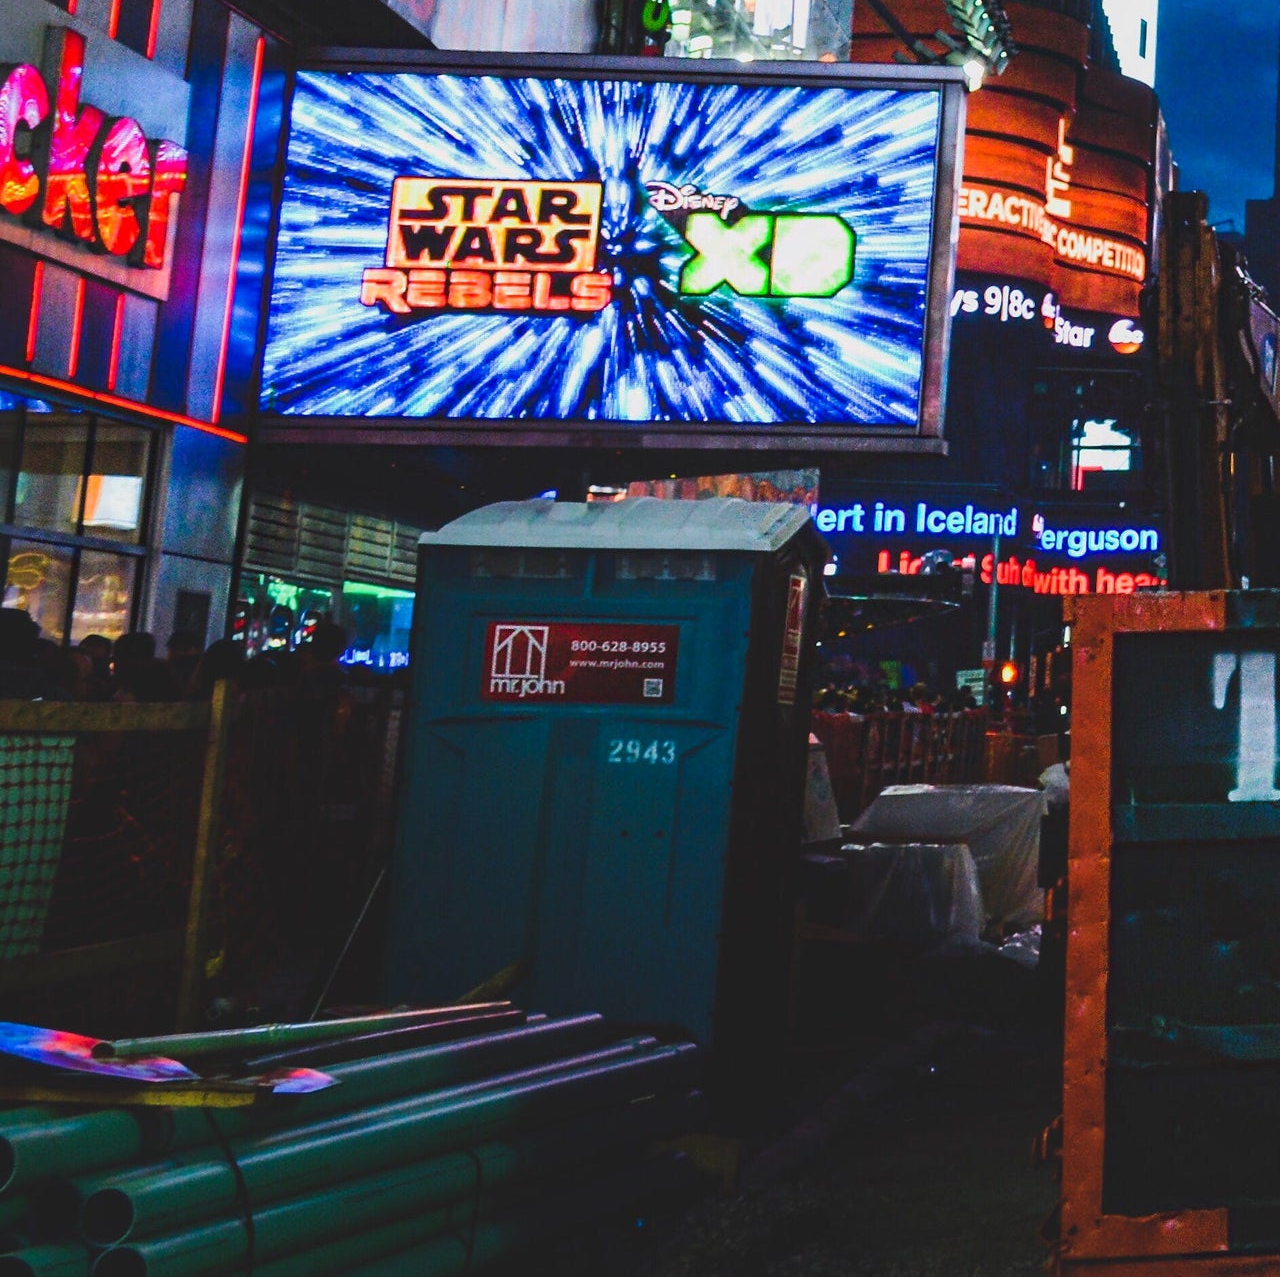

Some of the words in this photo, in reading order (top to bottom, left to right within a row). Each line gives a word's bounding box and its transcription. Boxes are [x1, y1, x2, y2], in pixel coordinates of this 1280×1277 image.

[400, 185, 582, 225] STAR
[399, 225, 589, 264] WARS
[680, 212, 857, 299] XD
[361, 267, 613, 315] REBELS
[811, 503, 865, 533] ert
[874, 502, 905, 532] in
[916, 502, 1018, 536] Iceland
[1033, 566, 1090, 595] with
[570, 639, 667, 655] 800-628-8955
[568, 658, 666, 671] www.mrjohn.com
[608, 739, 677, 766] 2943
